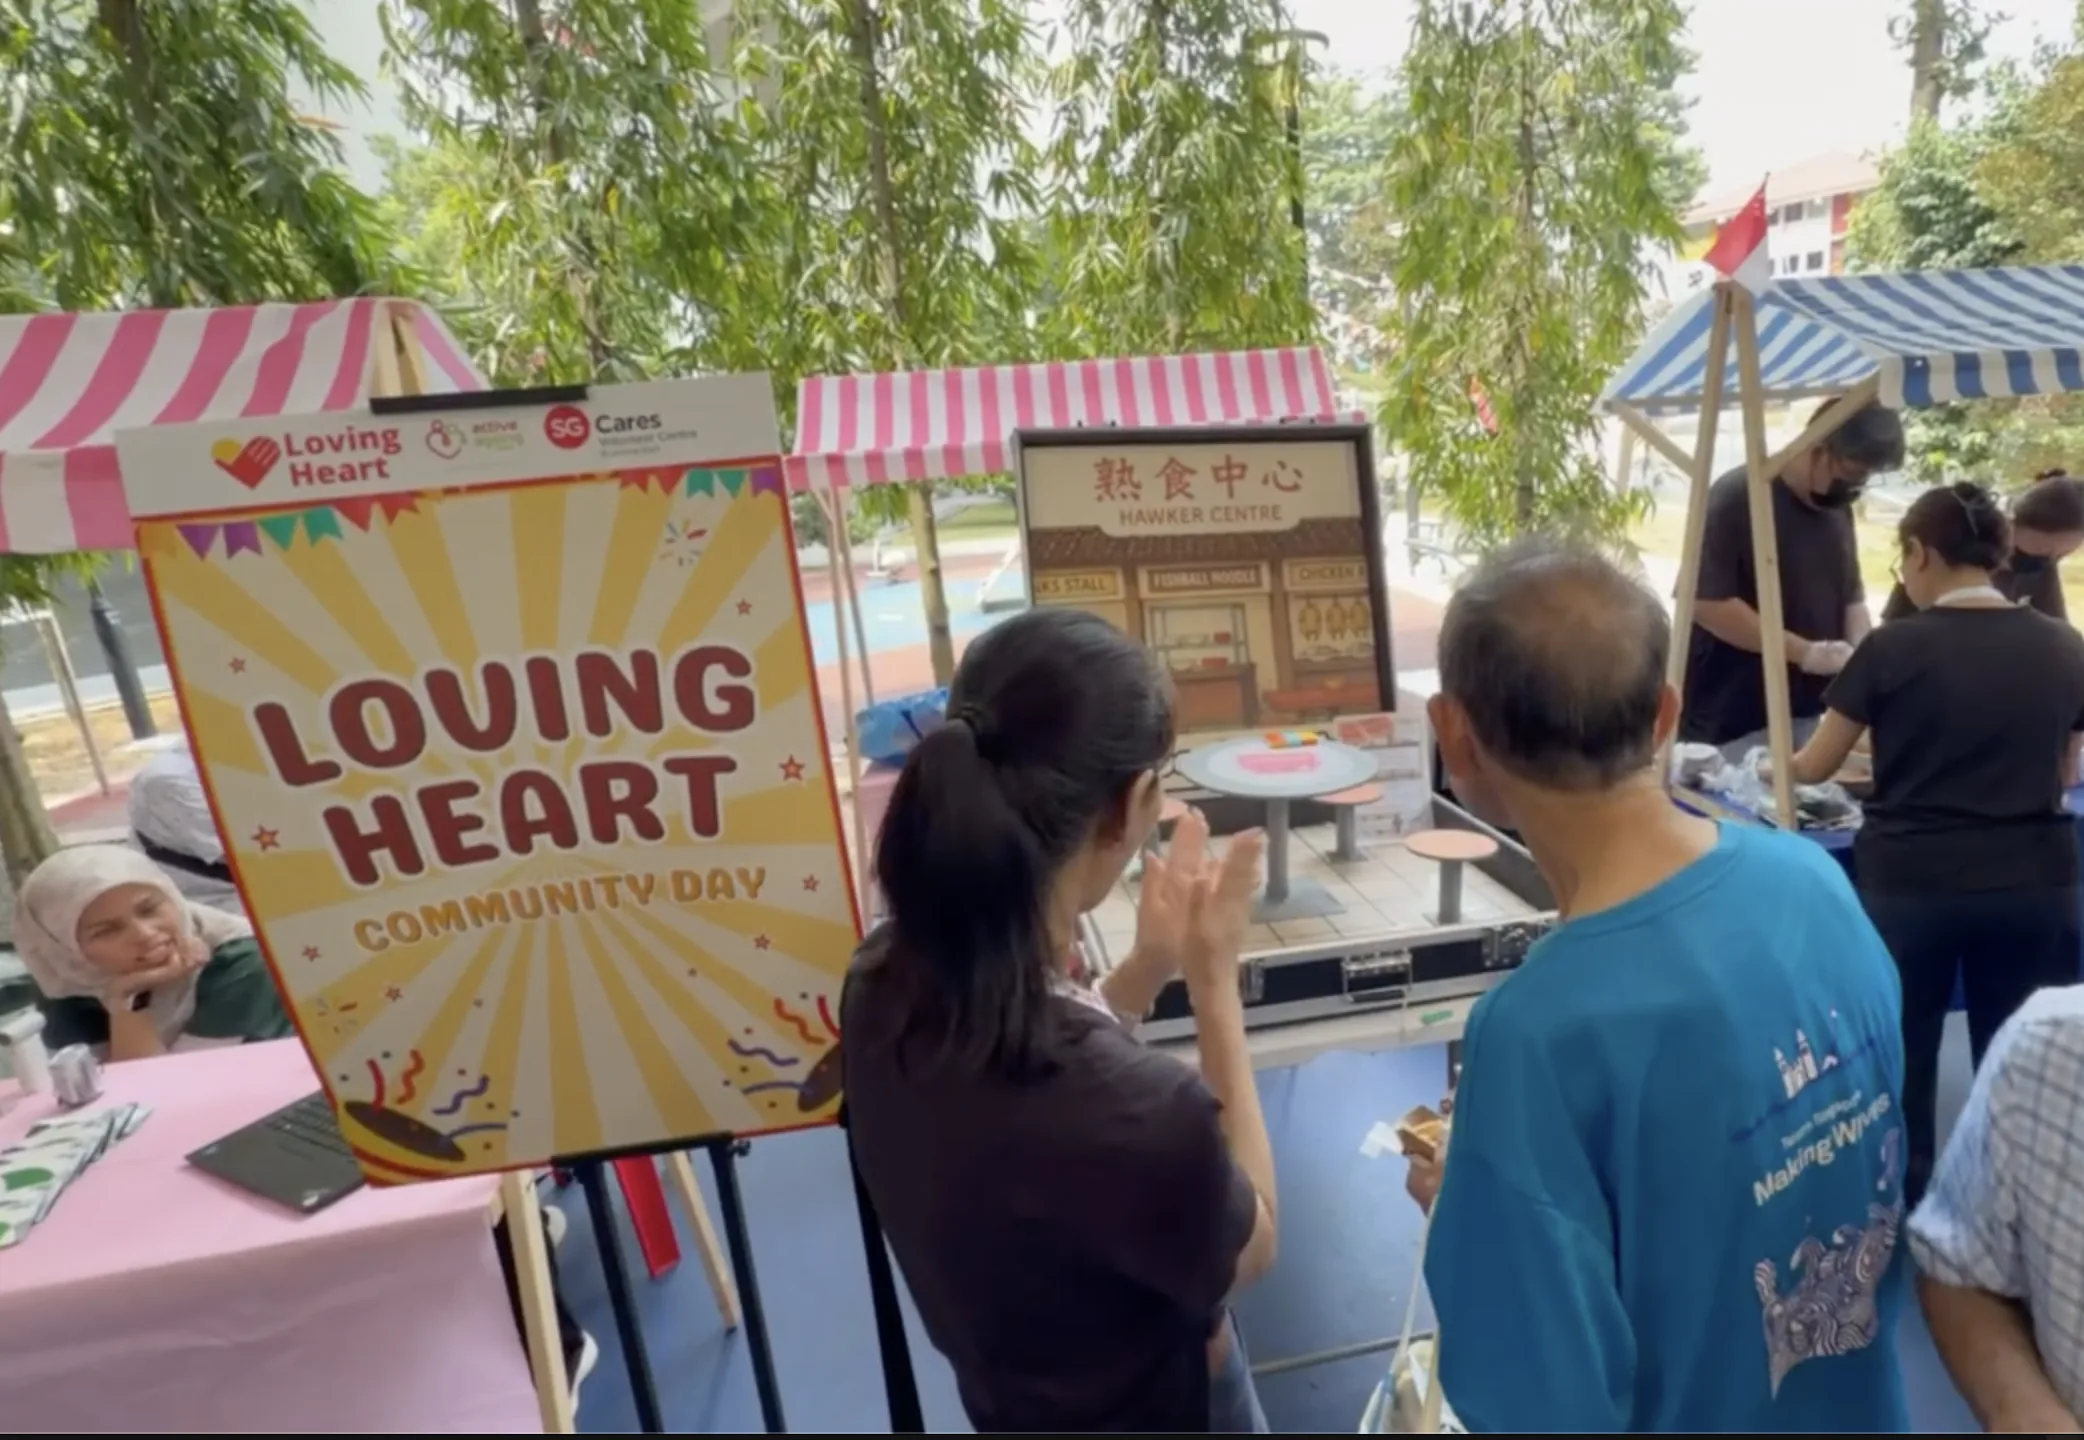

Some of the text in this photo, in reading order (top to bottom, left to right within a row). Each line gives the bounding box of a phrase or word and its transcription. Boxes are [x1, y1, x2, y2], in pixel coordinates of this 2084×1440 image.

[283, 425, 402, 456] Loving
[550, 412, 663, 439] SG Cares
[289, 457, 391, 488] Heart
[1092, 452, 1305, 502] 熟食中心
[1118, 504, 1283, 528] HAWKER CENTRE
[1065, 576, 1107, 593] STALL
[253, 645, 756, 787] LOVING
[322, 755, 738, 886] HEART
[353, 866, 767, 952] COMMUNITY DAY
[1753, 1135, 1835, 1207] Making
